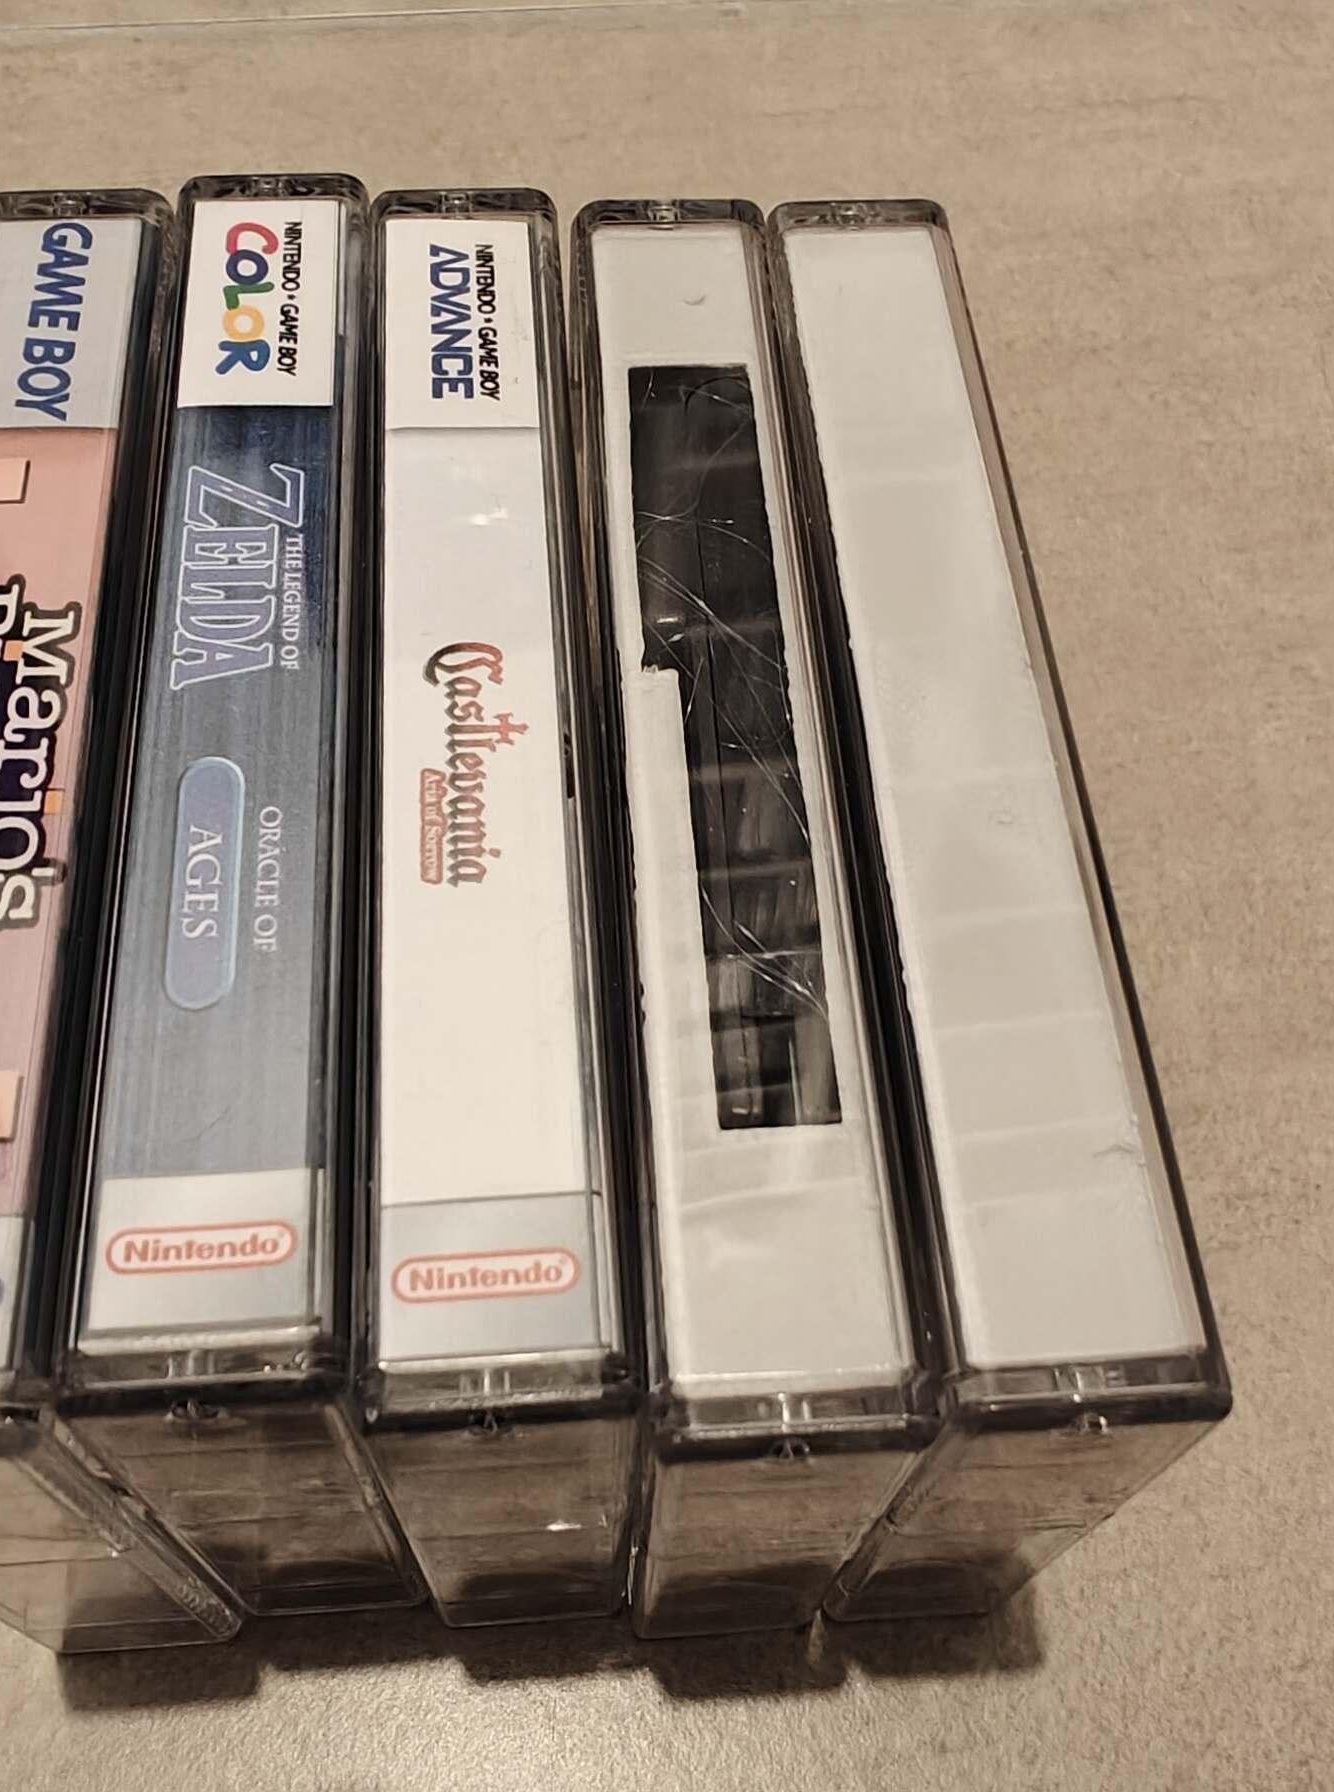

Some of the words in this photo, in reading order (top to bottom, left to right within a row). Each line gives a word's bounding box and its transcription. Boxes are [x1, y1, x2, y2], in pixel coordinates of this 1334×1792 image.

[27, 222, 93, 332] GAME
[281, 221, 303, 292] NINTENDO
[475, 244, 496, 315] NINTENDO
[215, 222, 280, 376] COLOR
[278, 303, 300, 345] GAME
[429, 243, 475, 400] ADVANCE
[14, 337, 77, 422] BOY
[276, 346, 299, 377] BOY
[478, 327, 499, 368] GAME
[479, 369, 501, 401] BOY
[170, 463, 305, 690] ZELDA
[280, 533, 304, 569] THE
[280, 570, 302, 642] LEGEND
[280, 645, 299, 671] OF
[422, 641, 531, 888] Castlevania
[181, 824, 223, 939] AGES
[253, 806, 286, 907] ORACLE
[253, 913, 278, 953] OF
[124, 1232, 280, 1263] Nintendo
[409, 1260, 563, 1292] Nintendo
